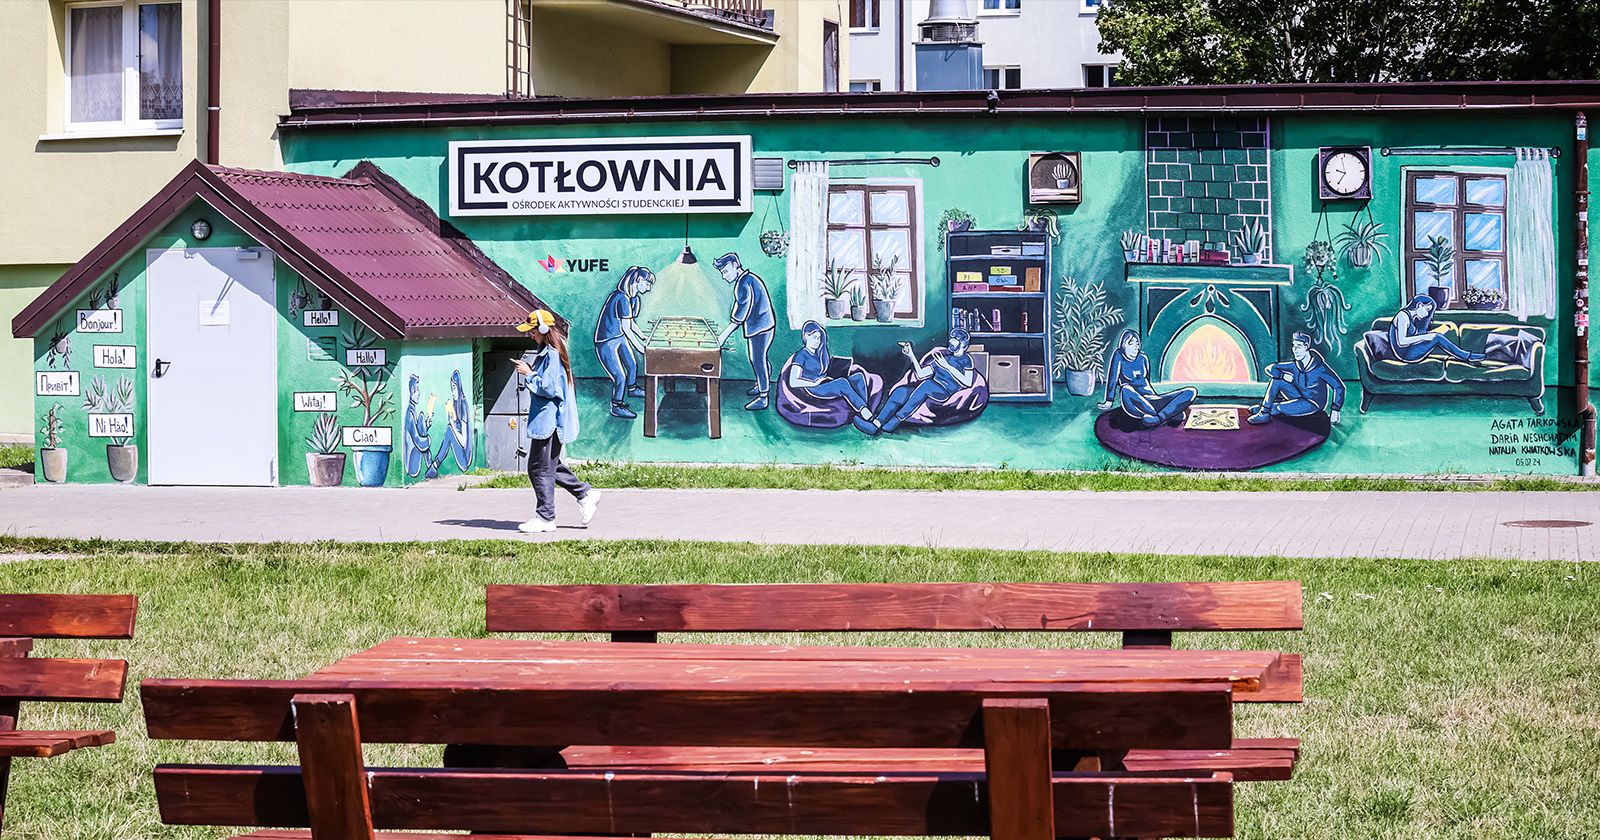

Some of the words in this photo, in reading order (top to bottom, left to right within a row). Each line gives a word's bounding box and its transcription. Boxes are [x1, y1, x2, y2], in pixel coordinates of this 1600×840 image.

[473, 158, 726, 194] KOTŁOWNIA
[512, 199, 556, 210] OŚRODEK
[557, 198, 620, 209] AKTYWNOŚCI
[622, 198, 685, 208] STUDENCKIEJ
[566, 259, 609, 272] YUFE
[80, 312, 118, 331] Bonjour!
[310, 312, 331, 325] Hello!
[102, 349, 126, 365] Hola!
[355, 351, 377, 364] Hallo!
[40, 374, 73, 393] Привіт!
[301, 395, 326, 410] Witaj!
[1491, 419, 1523, 431] AGATA
[352, 429, 378, 443] Ciao!
